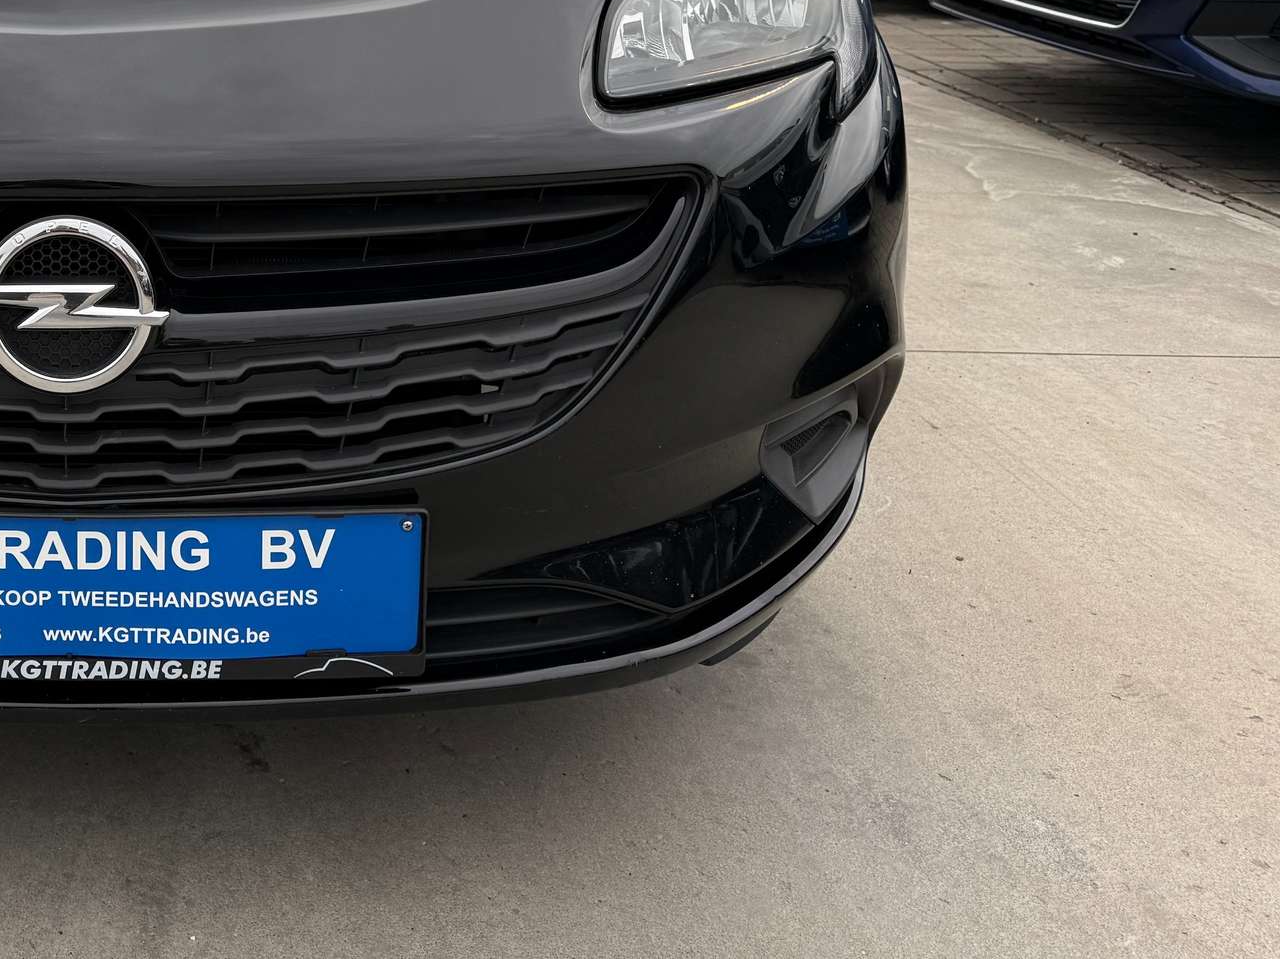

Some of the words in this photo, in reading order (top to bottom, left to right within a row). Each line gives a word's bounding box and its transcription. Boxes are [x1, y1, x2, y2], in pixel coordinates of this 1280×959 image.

[261, 528, 336, 570] BV
[57, 589, 318, 608] TWEEDEHANDSWAGENS
[43, 626, 270, 644] www.KGTTRADING.be
